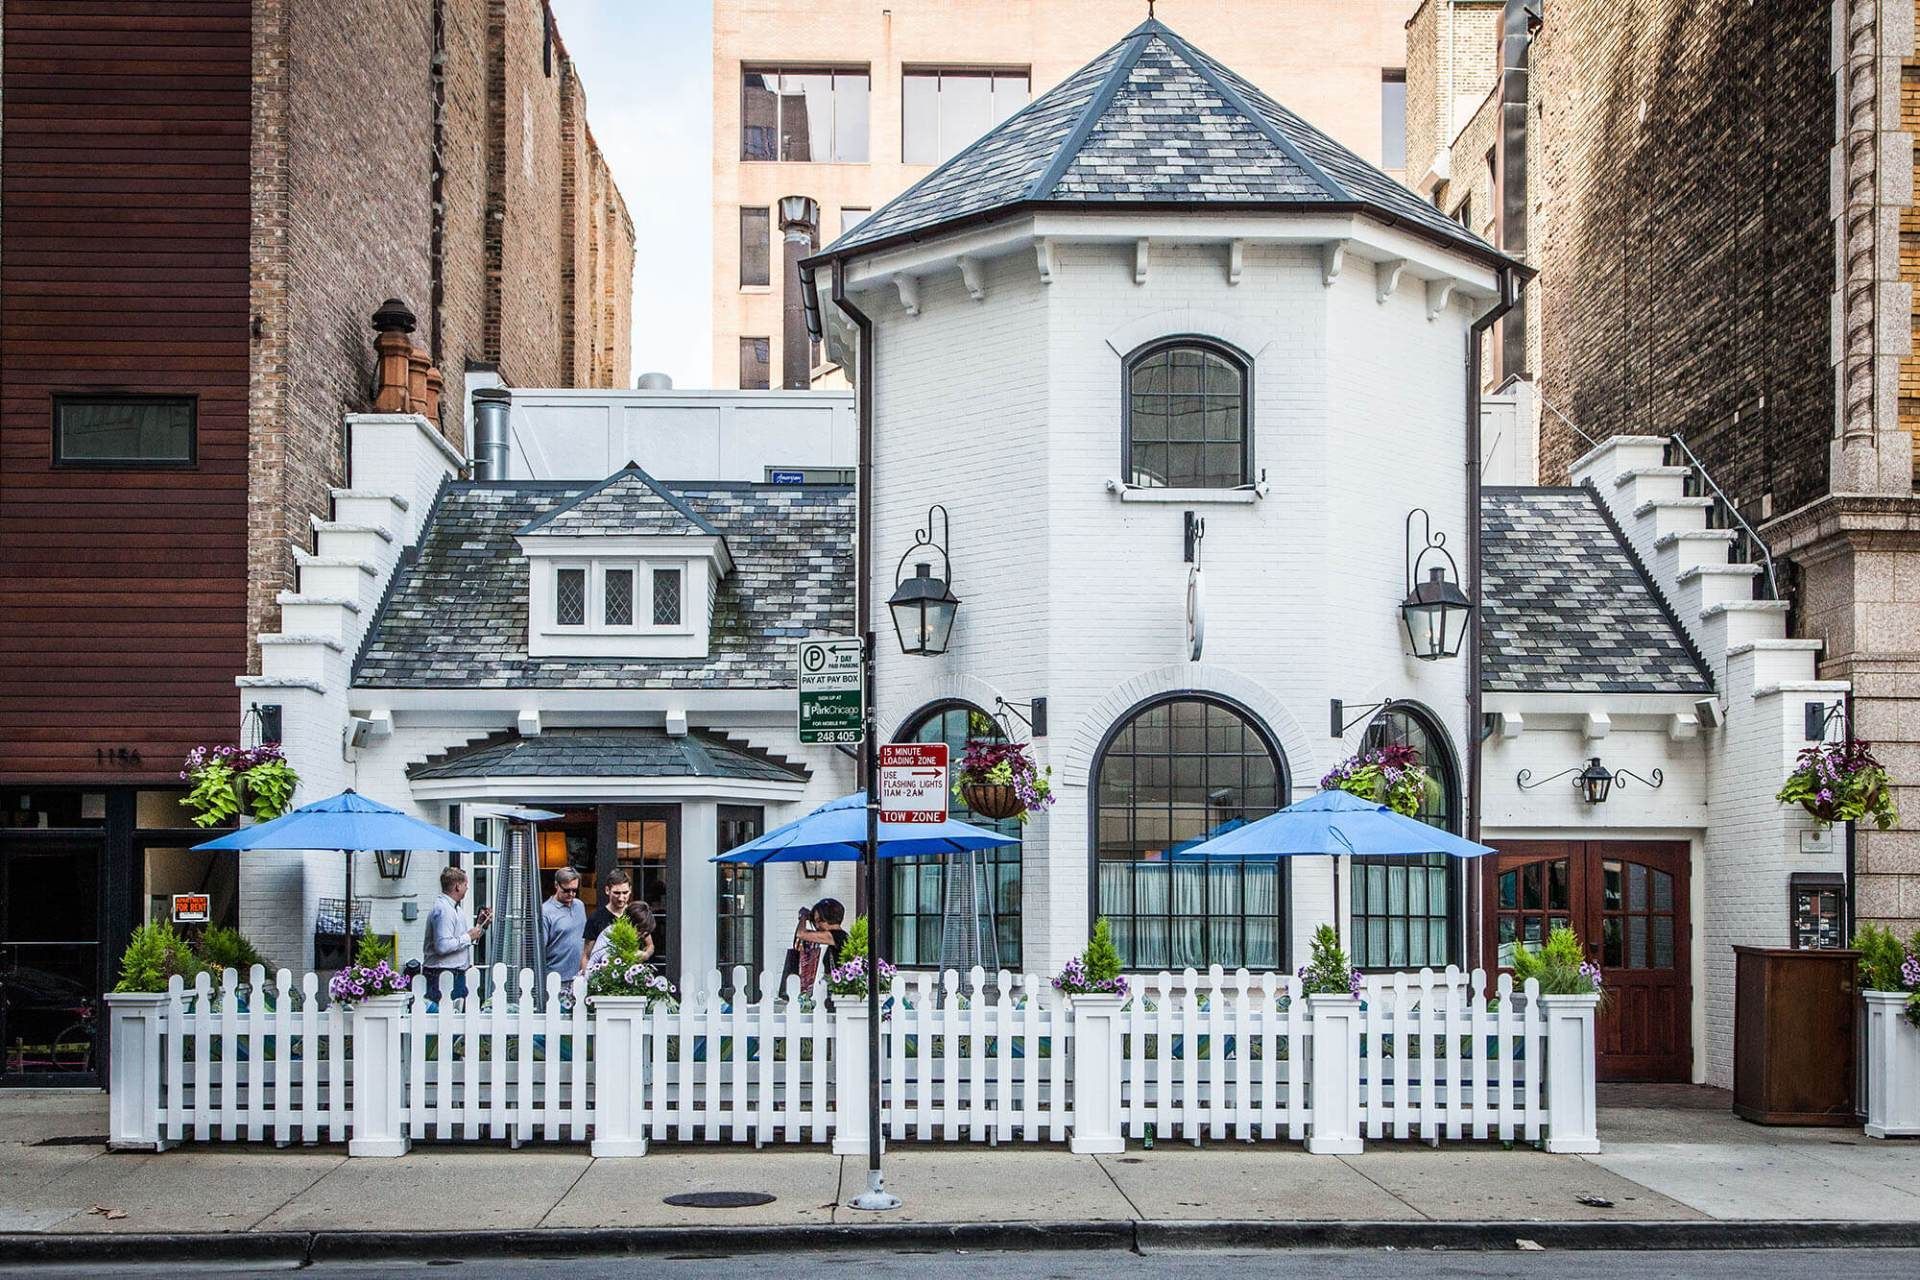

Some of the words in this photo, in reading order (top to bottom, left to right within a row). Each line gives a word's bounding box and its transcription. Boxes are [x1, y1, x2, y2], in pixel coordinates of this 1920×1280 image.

[810, 650, 820, 667] P
[802, 676, 815, 684] PAY
[816, 676, 826, 684] AT
[827, 675, 840, 683] PAY
[842, 675, 859, 683] BOX
[811, 705, 859, 716] ParkChicago
[817, 731, 835, 741] 248
[837, 731, 855, 741] 405
[883, 747, 892, 756] 15
[895, 747, 922, 756] MINUTE
[883, 756, 914, 765] LOADING
[918, 756, 937, 765] ZONE
[883, 771, 897, 779] USE
[883, 780, 916, 788] FLASHING
[920, 780, 943, 788] LIGHTS
[884, 811, 906, 822] TOW
[911, 811, 941, 822] ZONE
[176, 903, 188, 912] FOR
[190, 903, 207, 912] RENT
